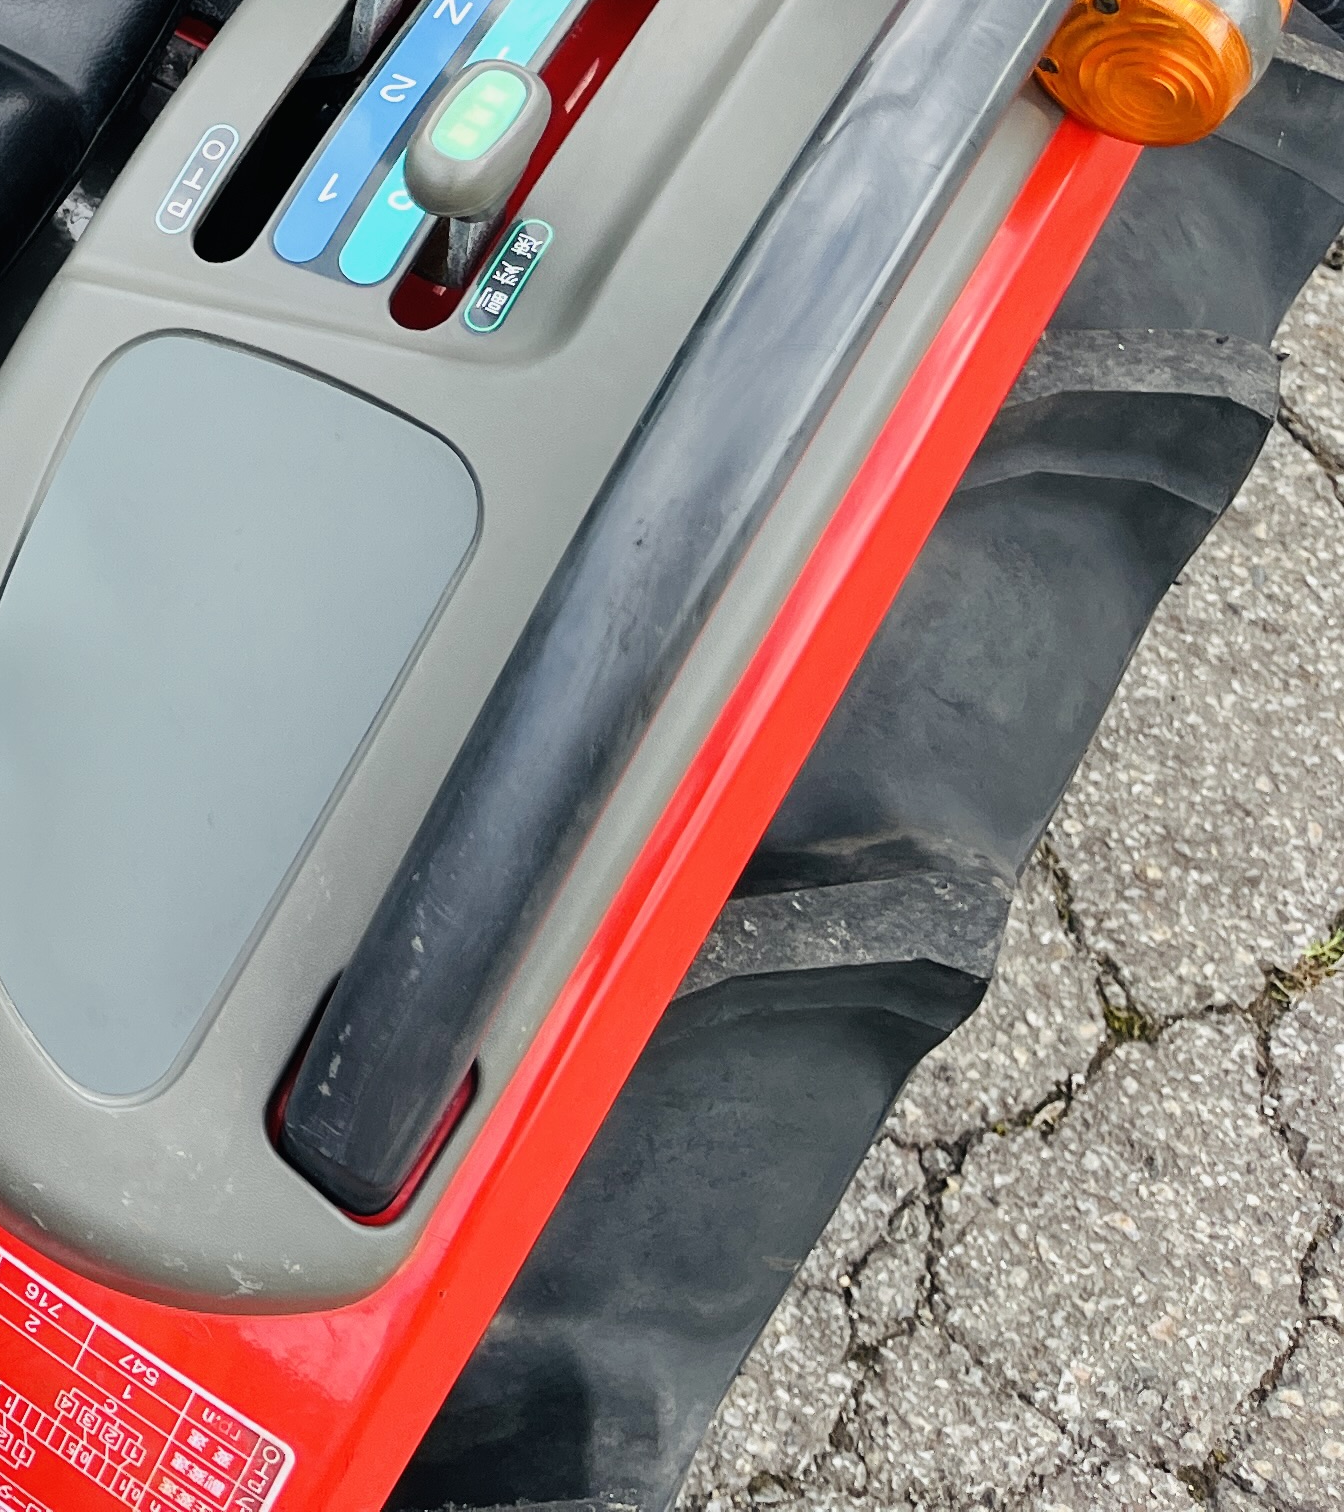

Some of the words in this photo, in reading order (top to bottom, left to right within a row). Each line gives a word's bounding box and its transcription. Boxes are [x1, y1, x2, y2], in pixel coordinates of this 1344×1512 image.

[380, 74, 417, 103] 2
[164, 138, 226, 224] PTO
[318, 173, 342, 203] 1
[474, 231, 547, 316] 副変速
[25, 1281, 64, 1320] 716
[24, 1314, 41, 1334] 2
[118, 1353, 160, 1387] 547
[60, 1395, 74, 1409] 4
[122, 1384, 132, 1400] 1
[3, 1396, 13, 1409] 1
[104, 1398, 118, 1413] C
[82, 1413, 96, 1428] 3
[104, 1429, 119, 1444] 2
[18, 1446, 28, 1460] 1
[129, 1446, 140, 1460] 1
[170, 1451, 226, 1498] 副変速
[247, 1445, 281, 1495] PTO
